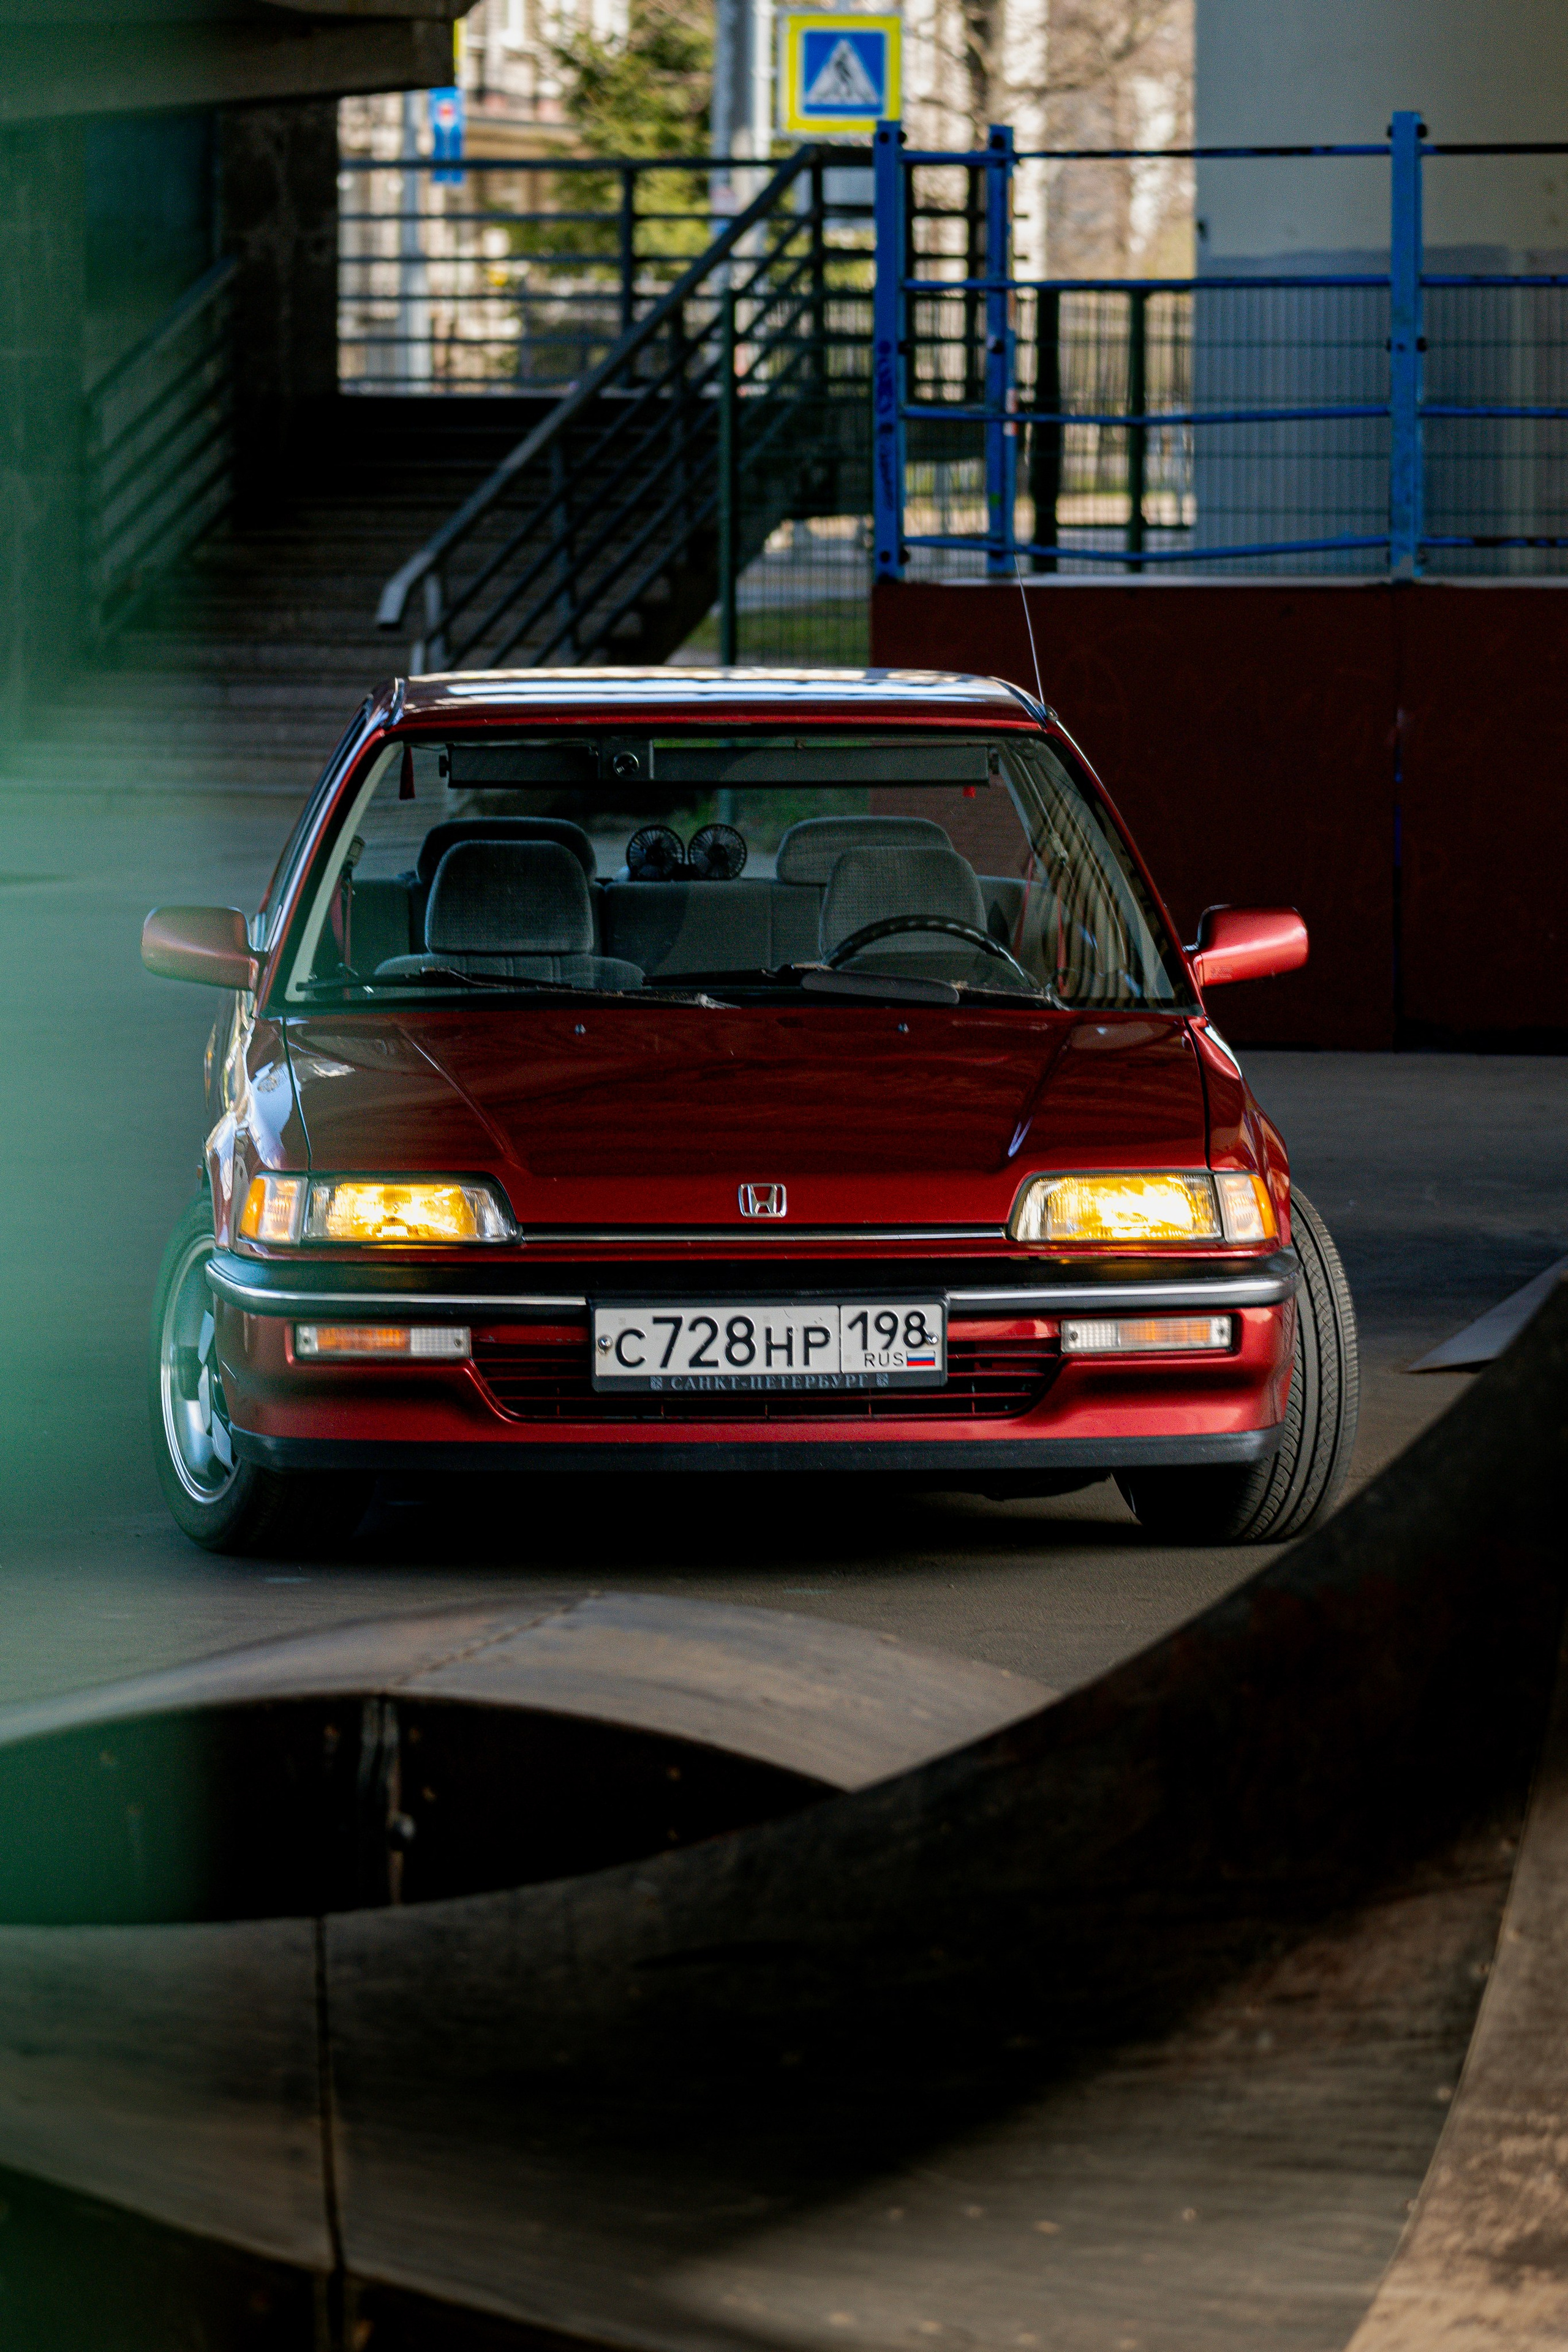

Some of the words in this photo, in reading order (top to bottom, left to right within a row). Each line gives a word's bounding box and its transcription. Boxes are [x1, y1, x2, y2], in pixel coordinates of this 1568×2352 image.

[616, 1315, 831, 1368] С728НР
[848, 1311, 927, 1351] 198
[864, 1352, 903, 1367] RUS
